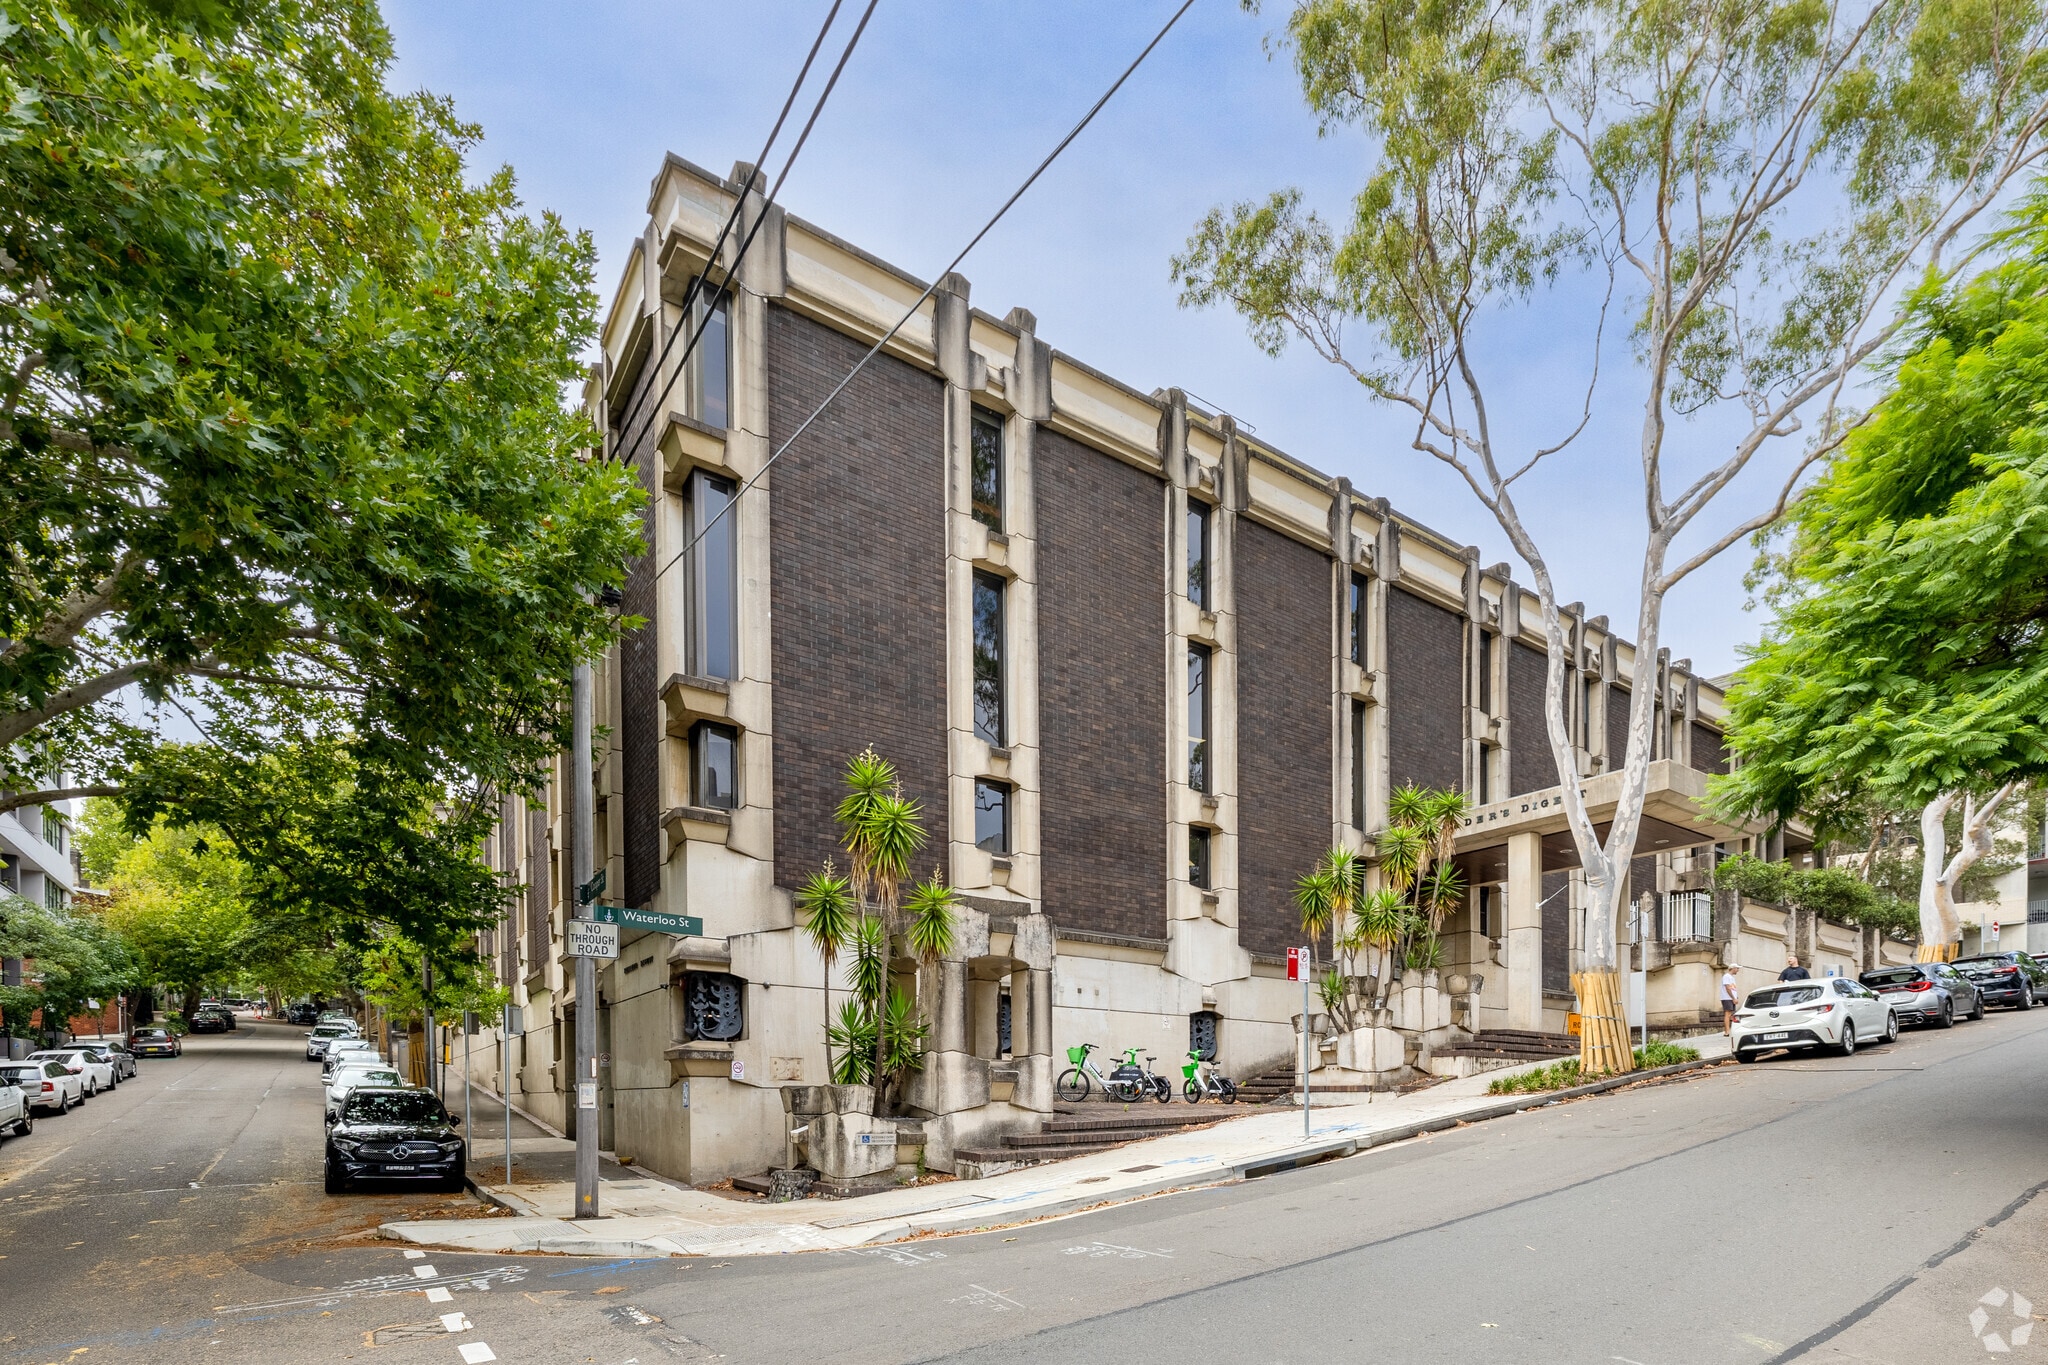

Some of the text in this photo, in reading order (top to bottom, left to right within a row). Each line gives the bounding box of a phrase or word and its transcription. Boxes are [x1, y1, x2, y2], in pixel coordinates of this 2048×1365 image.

[1464, 789, 1587, 827] DER'S DIGET
[622, 910, 689, 928] Waterloo St
[585, 924, 601, 934] NO
[570, 933, 615, 946] THROUGH
[577, 944, 609, 955] ROAD
[1573, 1021, 1581, 1029] RO
